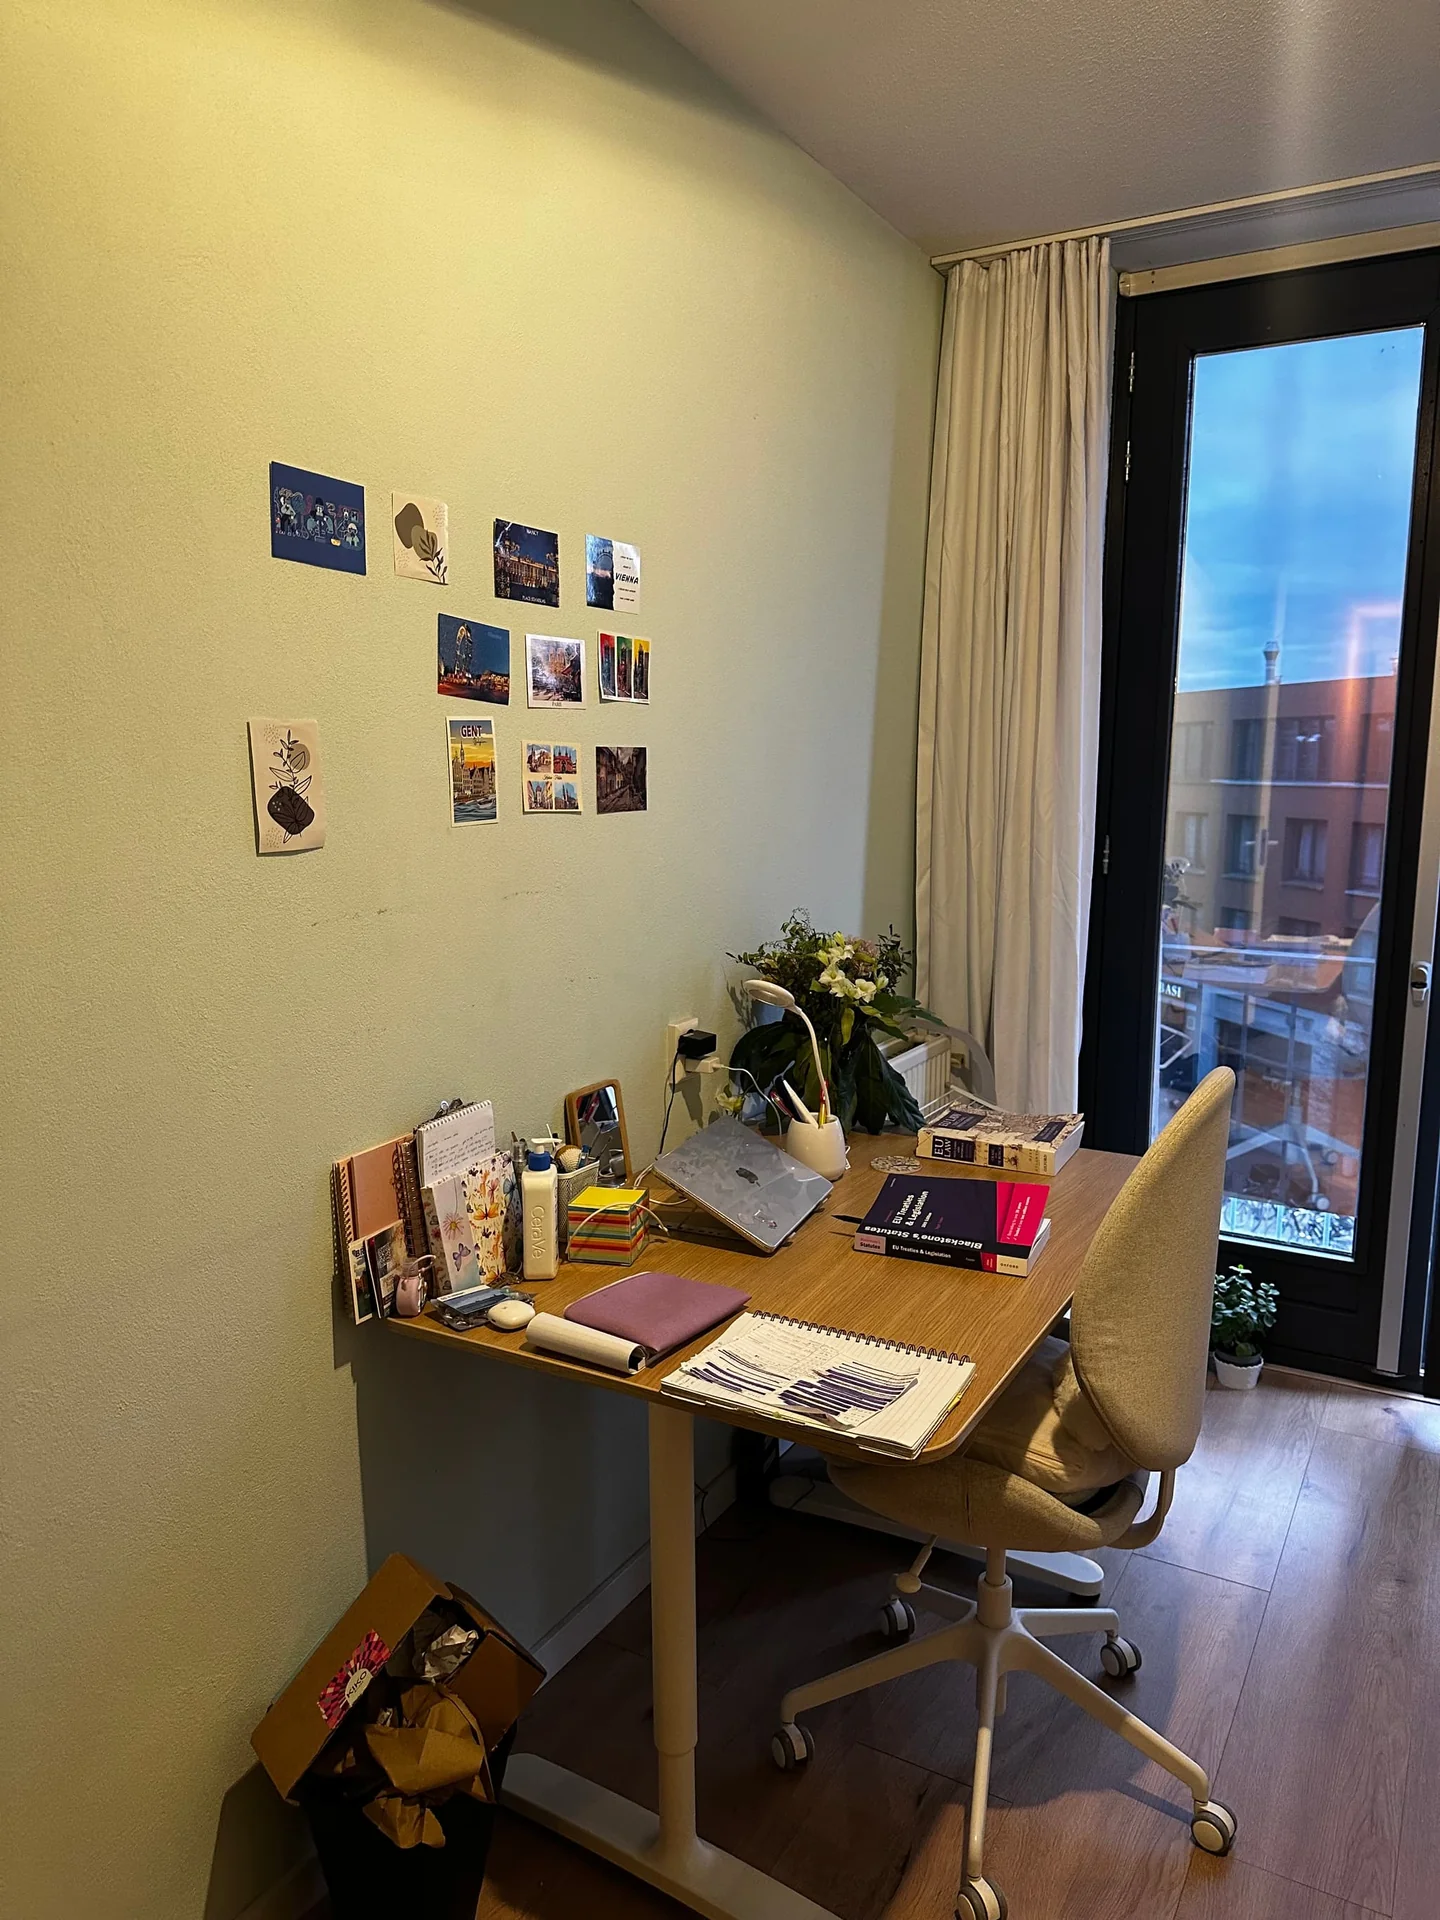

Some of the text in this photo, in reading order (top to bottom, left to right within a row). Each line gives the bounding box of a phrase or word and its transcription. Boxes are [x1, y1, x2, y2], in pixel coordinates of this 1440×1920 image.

[615, 572, 639, 584] VIENNA
[461, 725, 482, 738] GENT
[934, 1138, 944, 1156] EU
[892, 1195, 914, 1224] EU Treaties
[908, 1191, 929, 1221] Legislation
[530, 1206, 545, 1259] CeraVe
[864, 1225, 983, 1250] Blackstone's Statutes
[900, 1246, 919, 1254] Treaties
[925, 1250, 951, 1258] Legislation
[347, 1671, 367, 1698] KIKO
